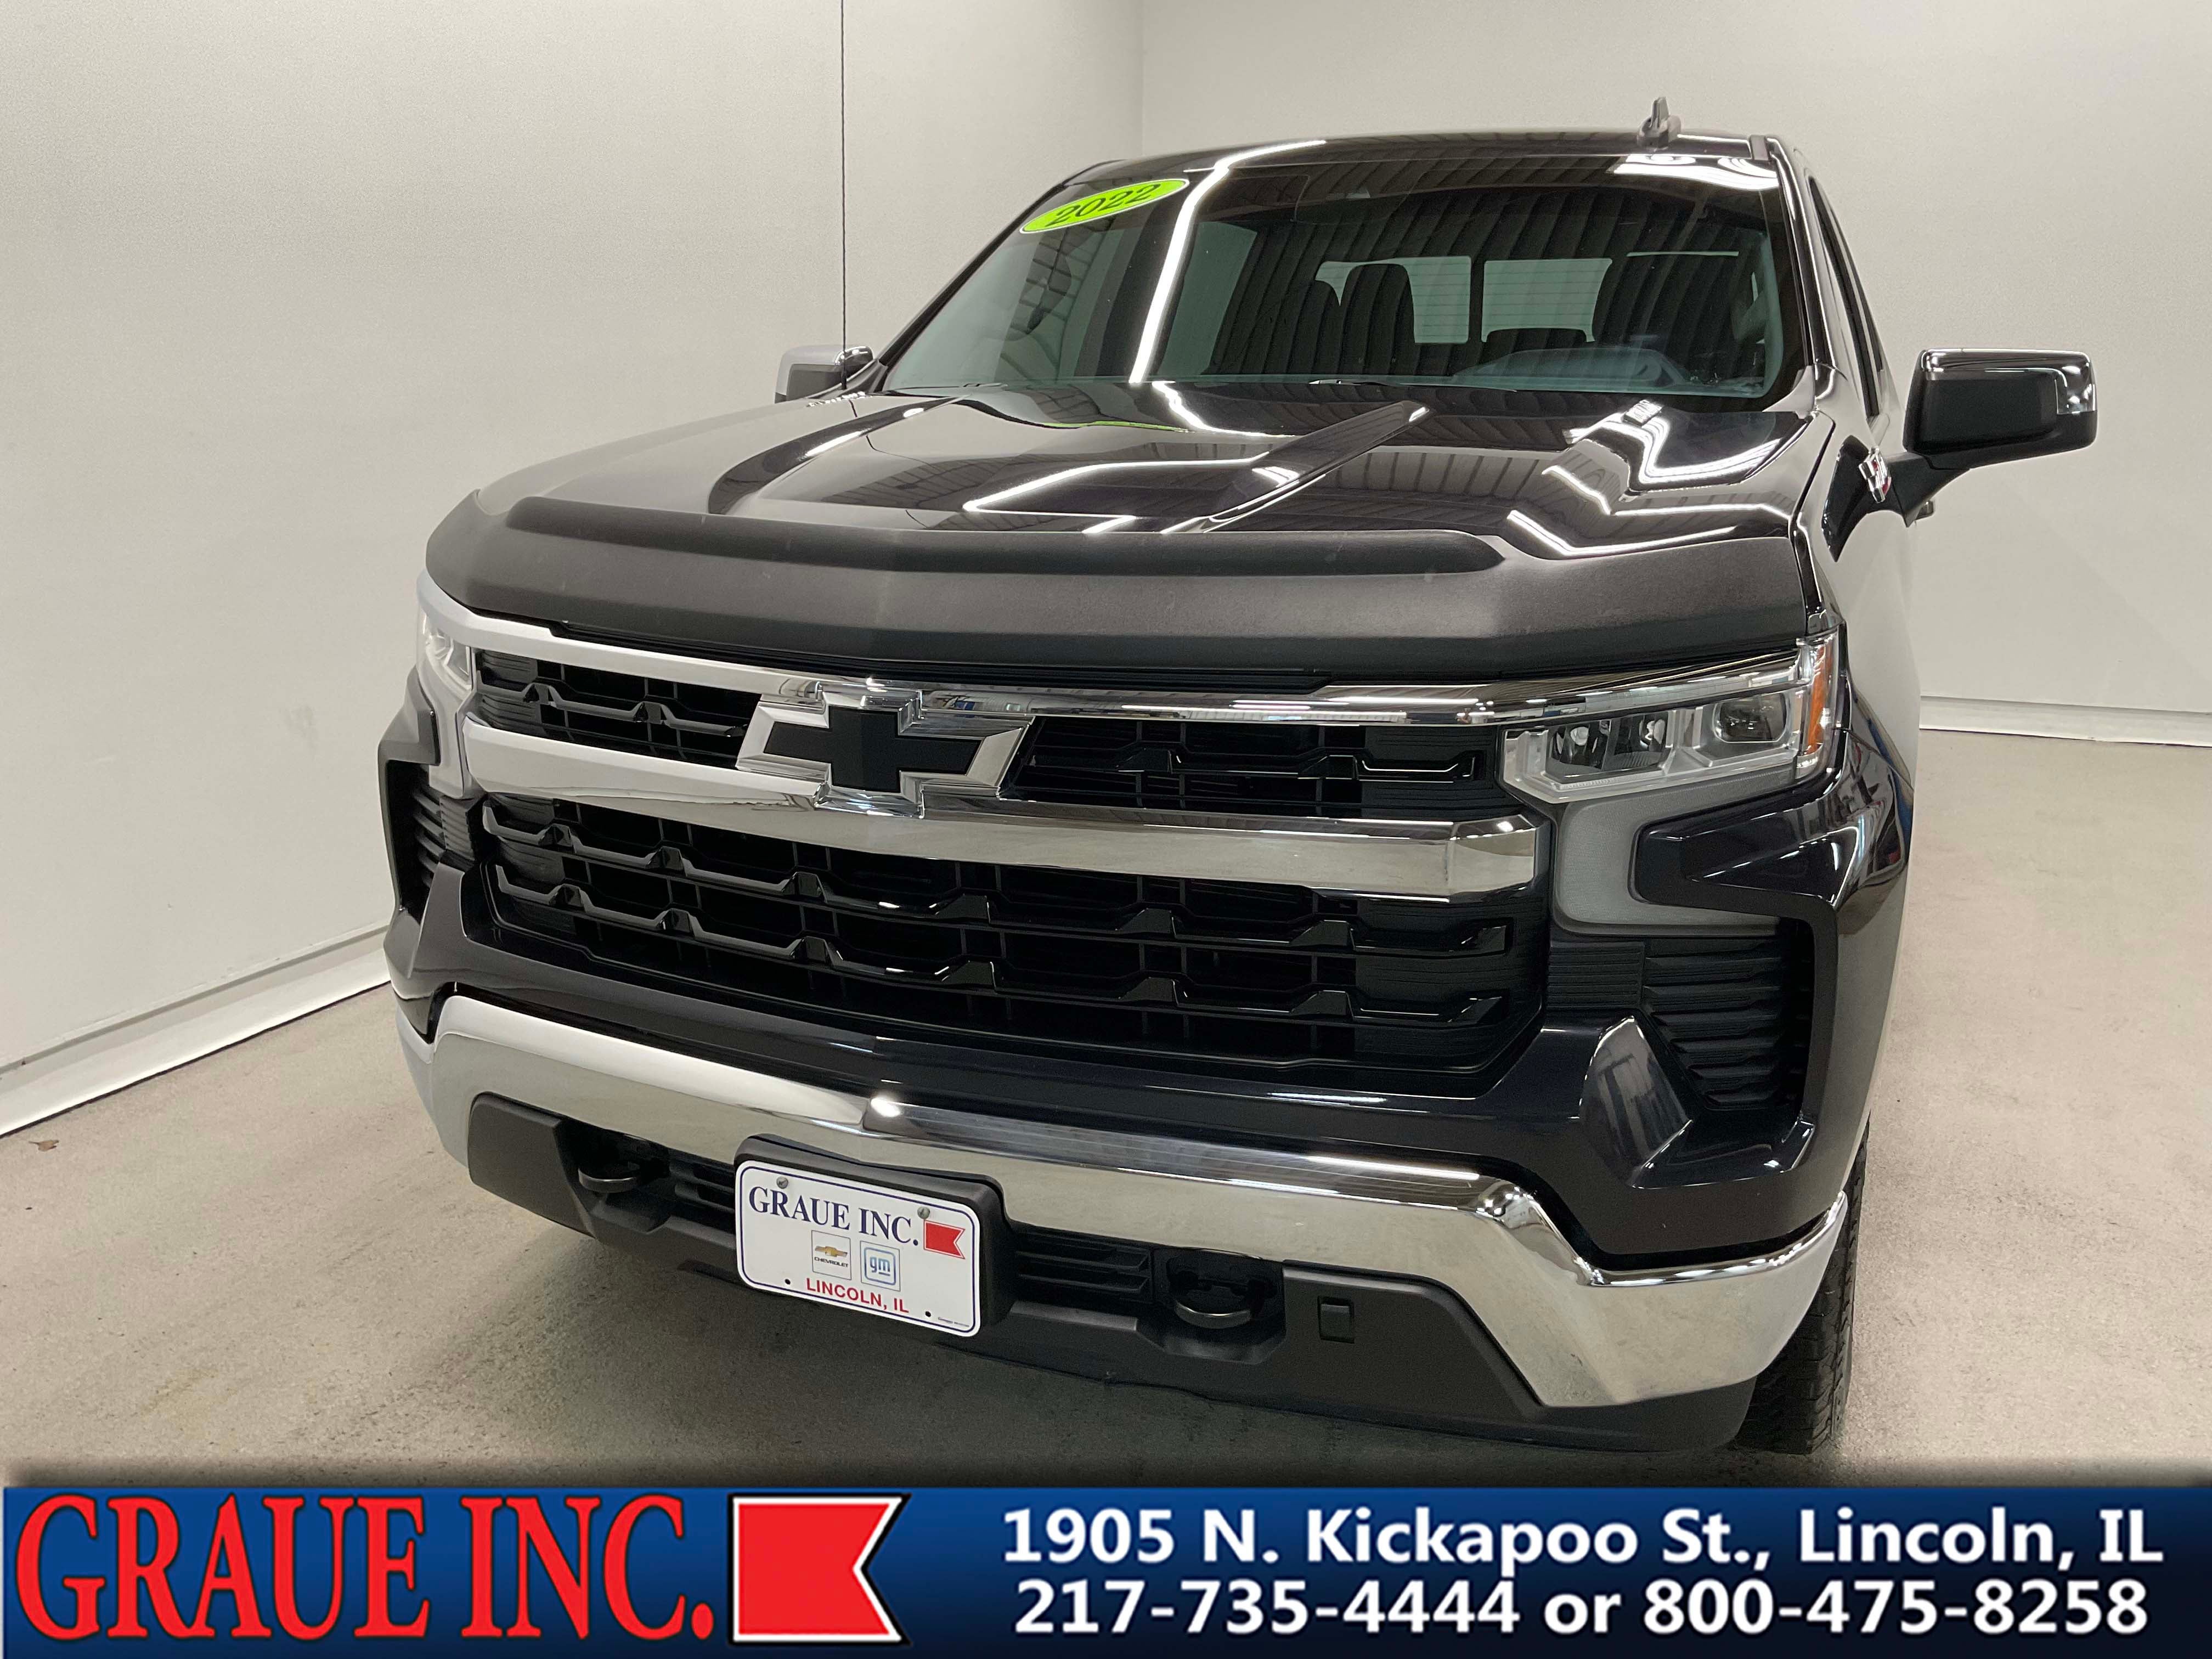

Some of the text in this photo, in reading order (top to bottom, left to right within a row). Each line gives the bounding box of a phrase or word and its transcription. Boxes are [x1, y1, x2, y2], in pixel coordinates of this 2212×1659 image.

[1045, 184, 1161, 227] 2022
[749, 1186, 918, 1246] GRAUE INC.
[814, 1256, 849, 1268] CHEVROLET
[806, 1278, 909, 1313] LINCOLN, IL
